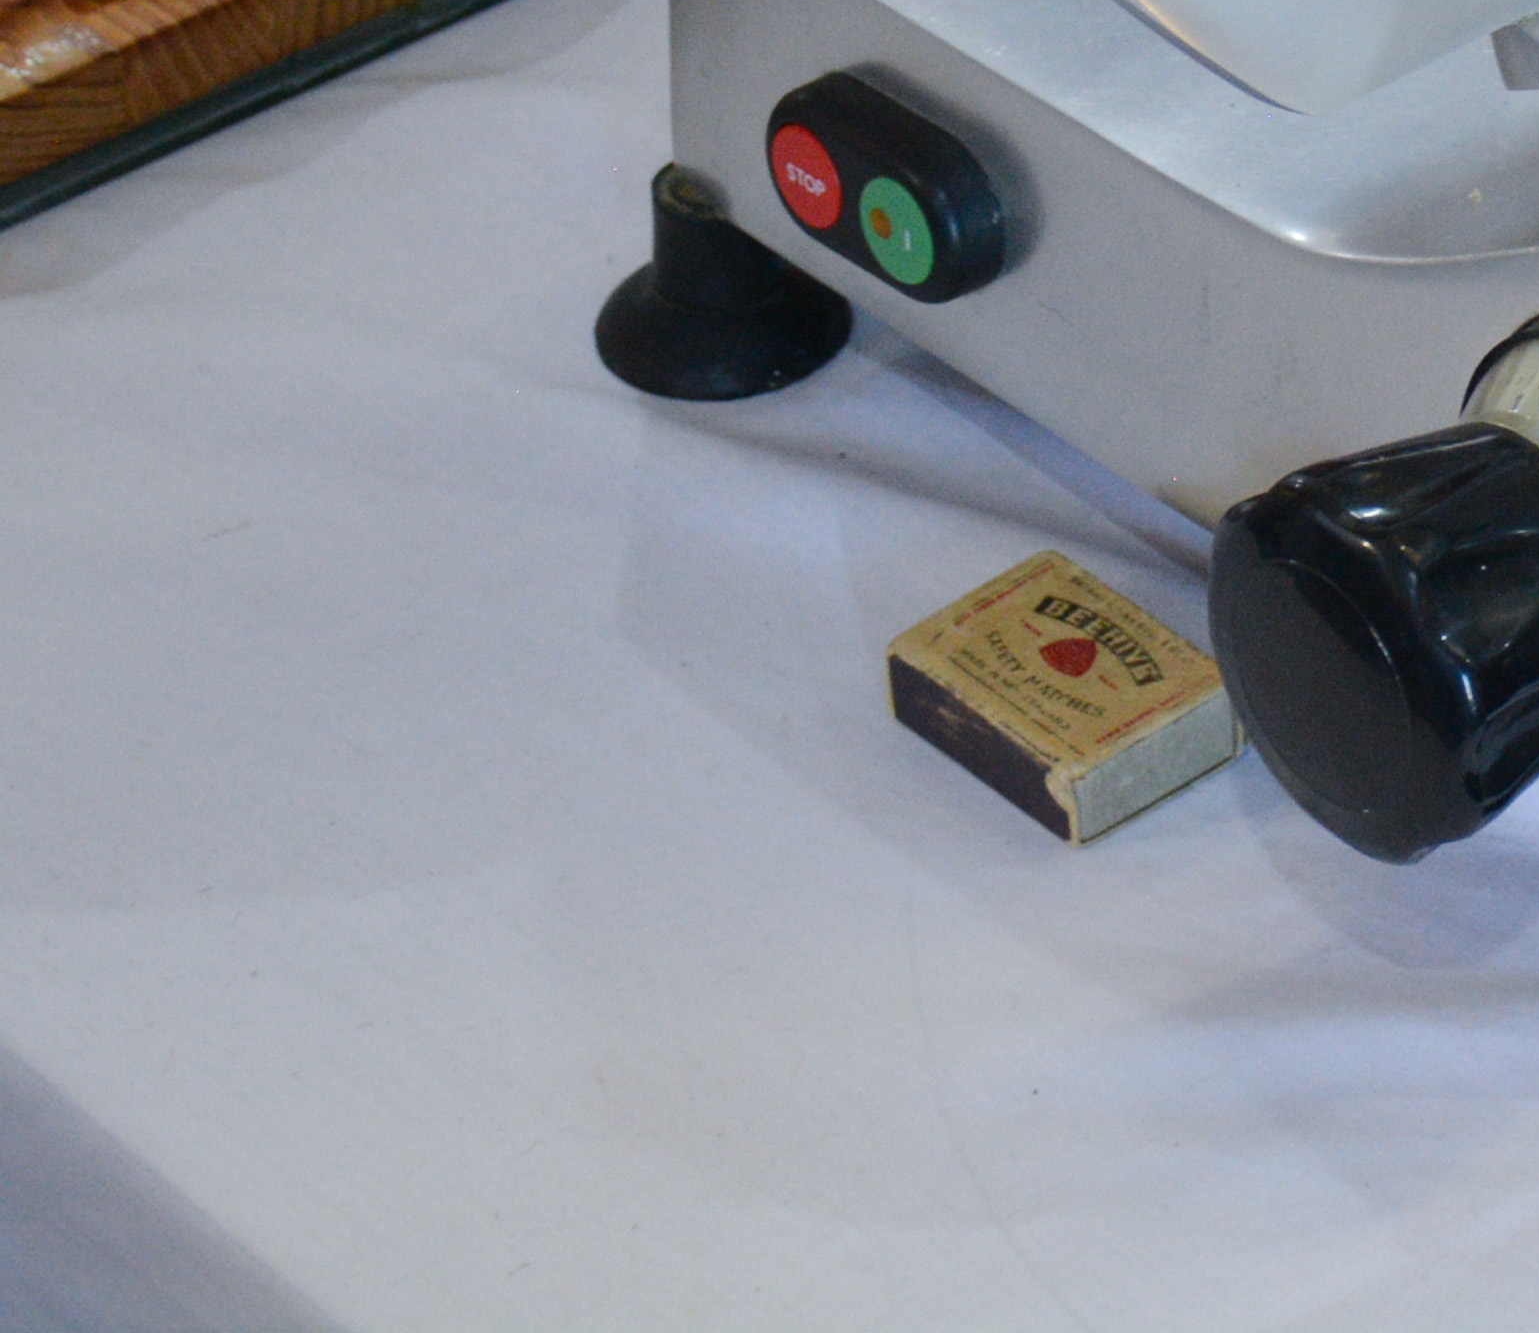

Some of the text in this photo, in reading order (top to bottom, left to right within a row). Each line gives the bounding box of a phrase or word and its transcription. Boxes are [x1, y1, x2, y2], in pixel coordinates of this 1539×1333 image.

[786, 161, 827, 198] STOP
[986, 631, 1107, 717] SAFETY MATCHES
[1042, 598, 1160, 685] BEEHIVE
